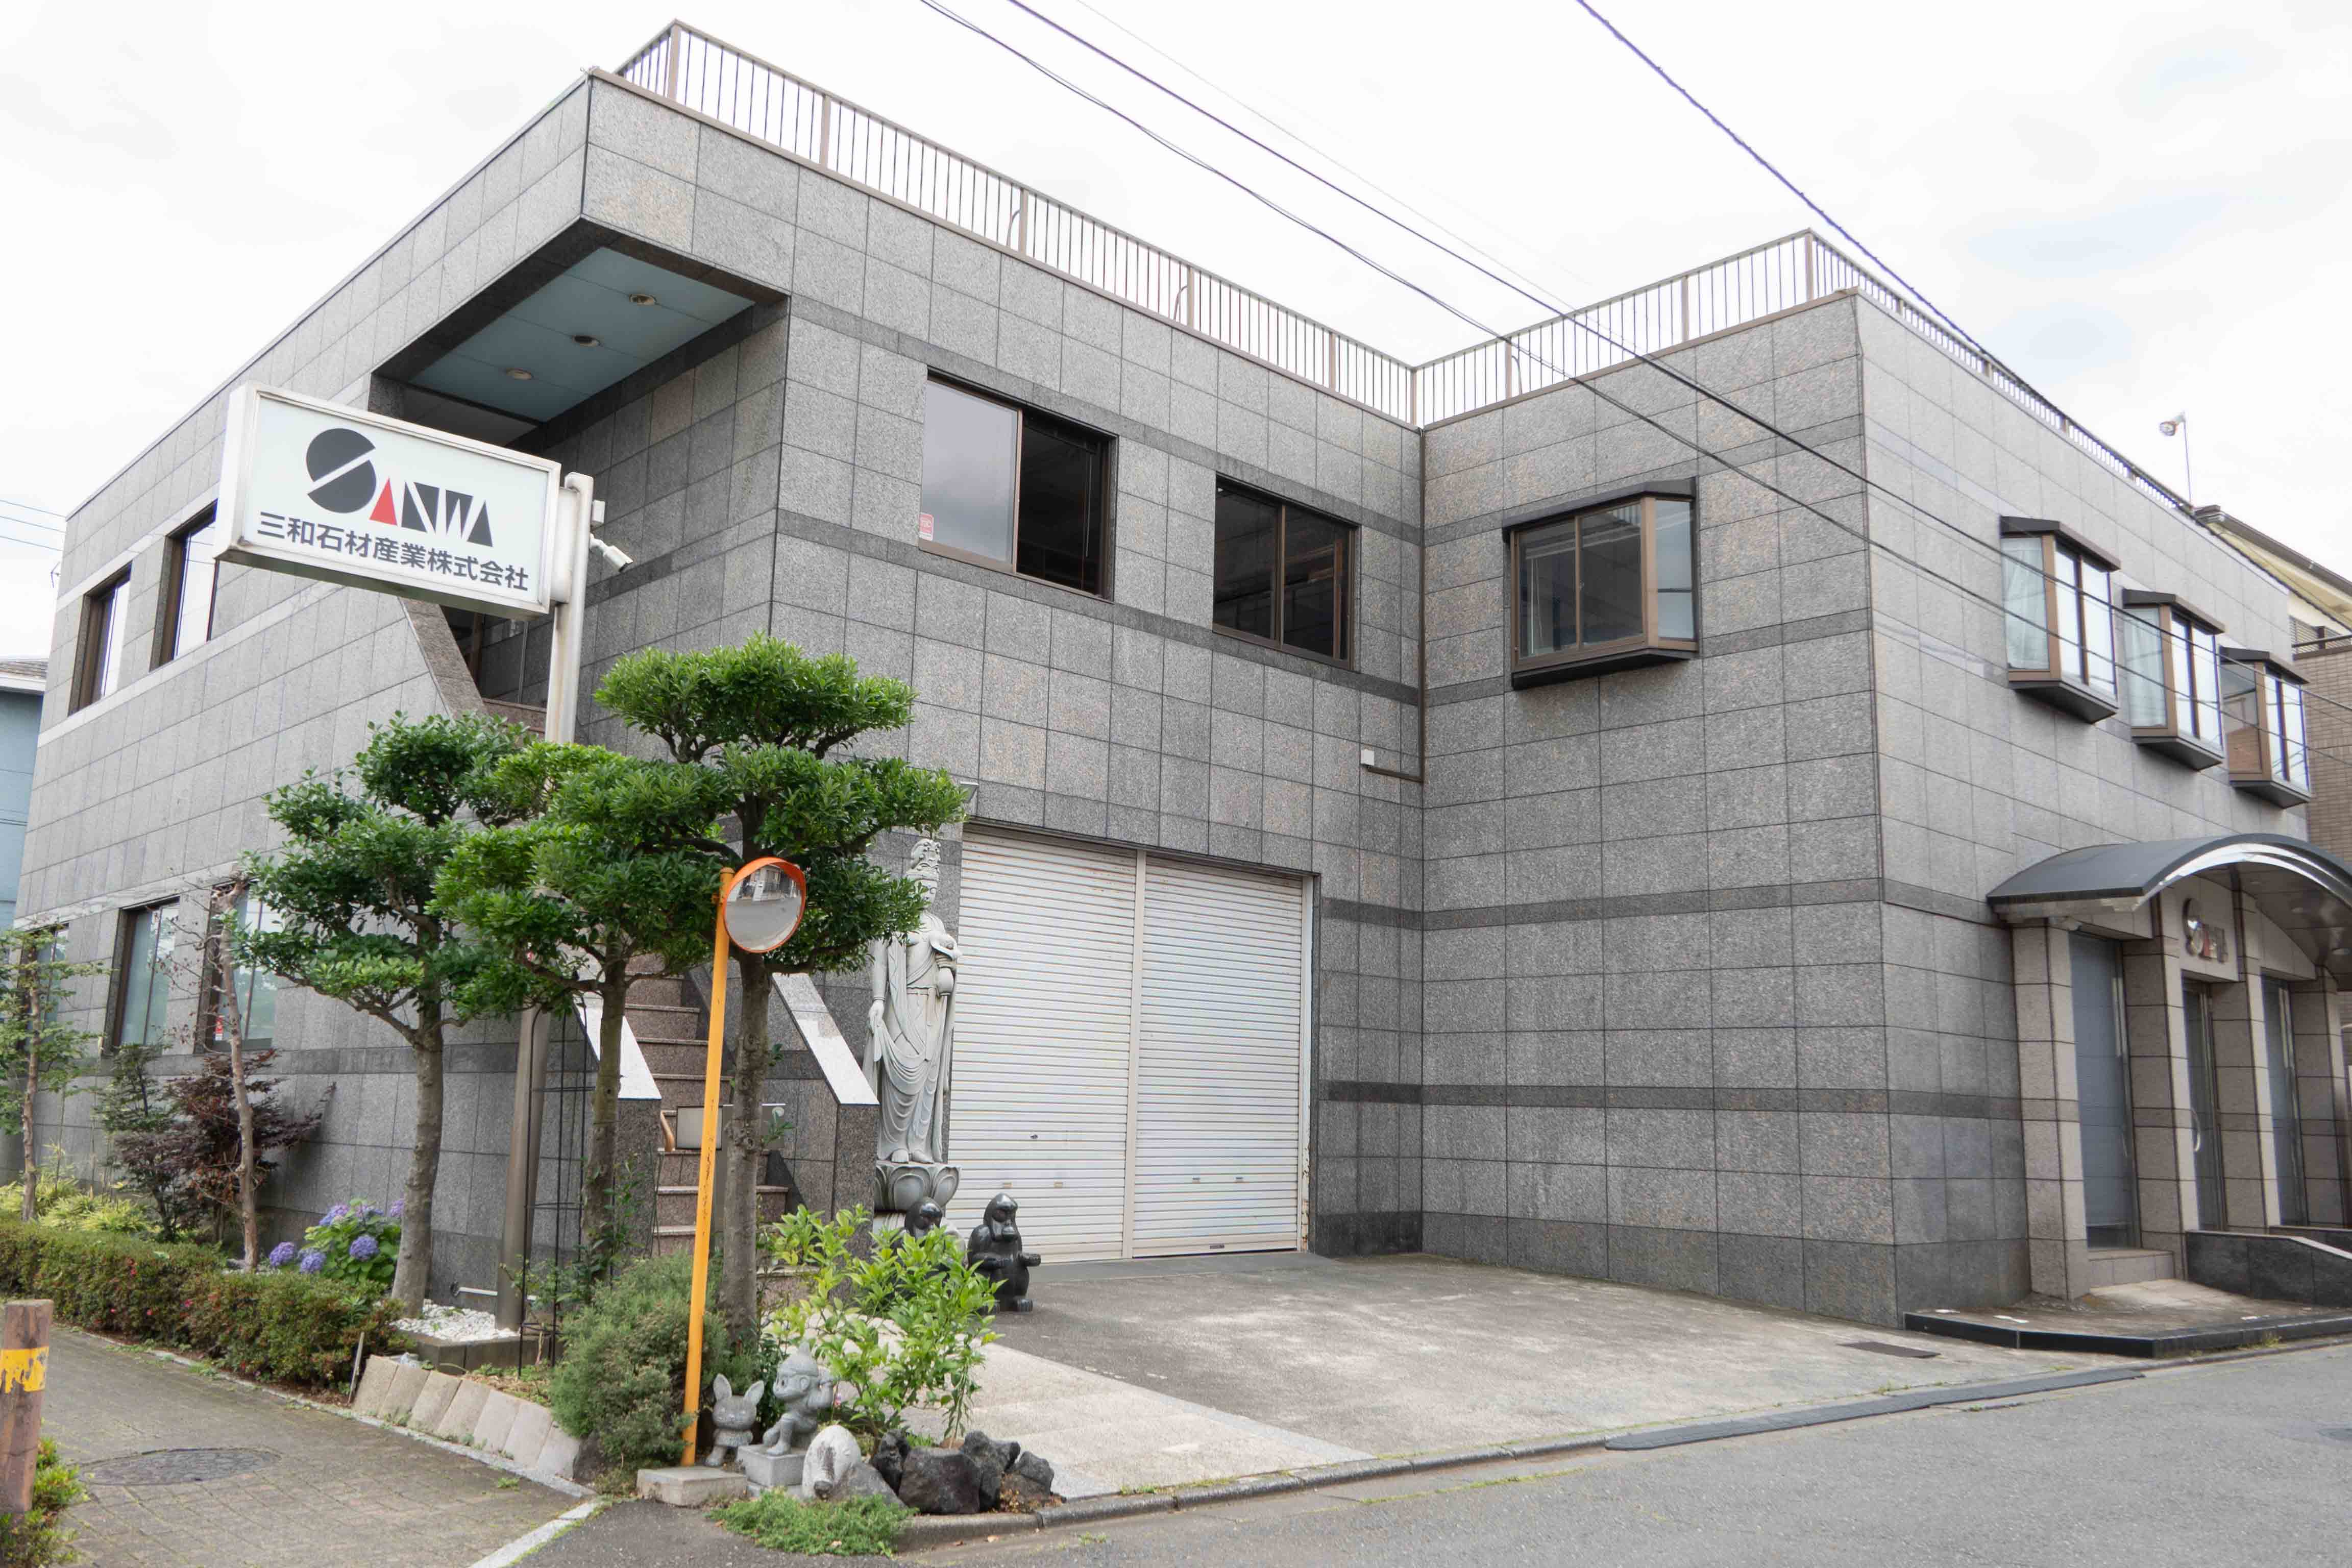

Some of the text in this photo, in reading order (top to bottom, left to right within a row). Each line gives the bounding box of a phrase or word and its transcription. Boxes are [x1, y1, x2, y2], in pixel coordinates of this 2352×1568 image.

[306, 428, 493, 548] SANWA
[258, 512, 529, 591] 三和石材産業株式会社
